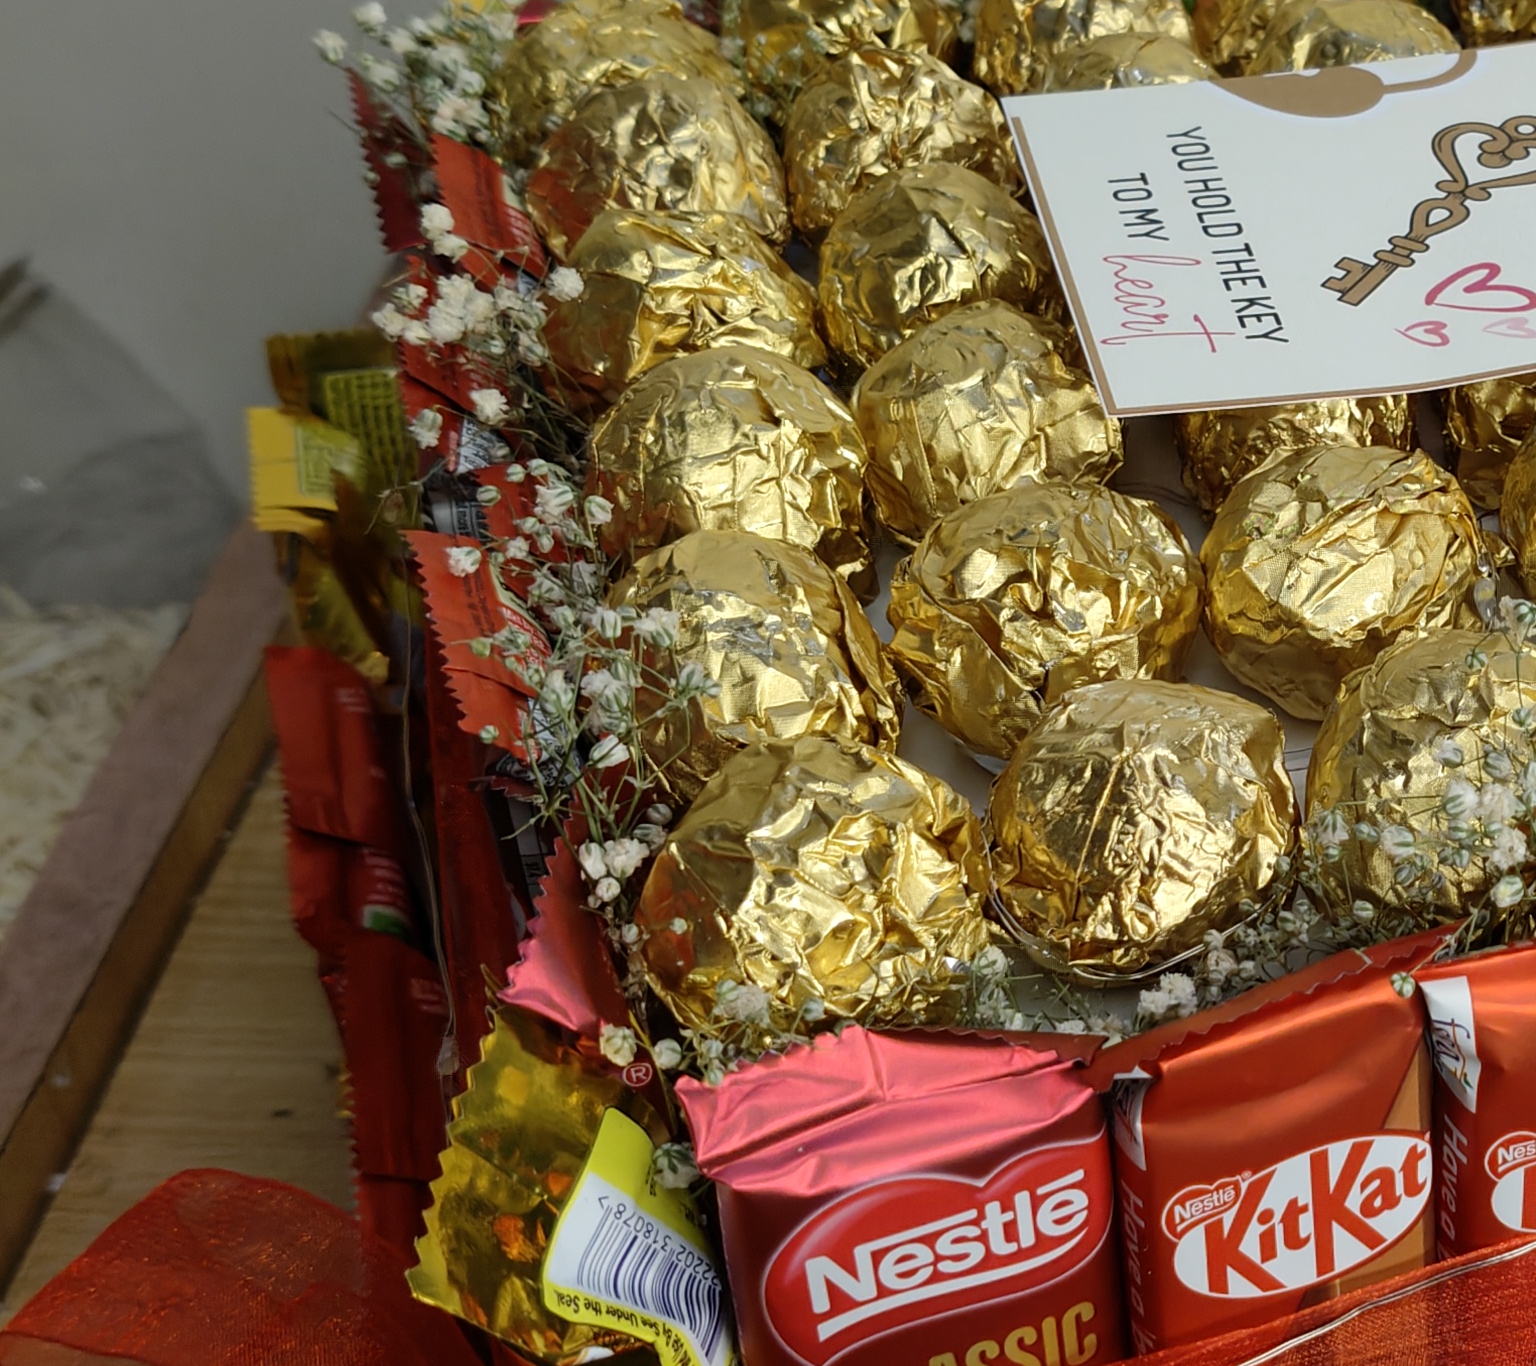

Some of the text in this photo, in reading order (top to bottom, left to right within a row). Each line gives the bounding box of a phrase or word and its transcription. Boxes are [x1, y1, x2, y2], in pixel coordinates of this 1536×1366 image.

[1165, 126, 1290, 343] YOU HOLD THE KEY
[1099, 172, 1237, 353] TO MY heart
[613, 1202, 674, 1253] 318078
[1173, 1184, 1237, 1232] Nestlé
[1203, 1138, 1429, 1295] KitKat
[804, 1167, 1091, 1325] Nestlé
[583, 1298, 603, 1316] the
[605, 1304, 640, 1328] Under
[640, 1316, 661, 1336] See
